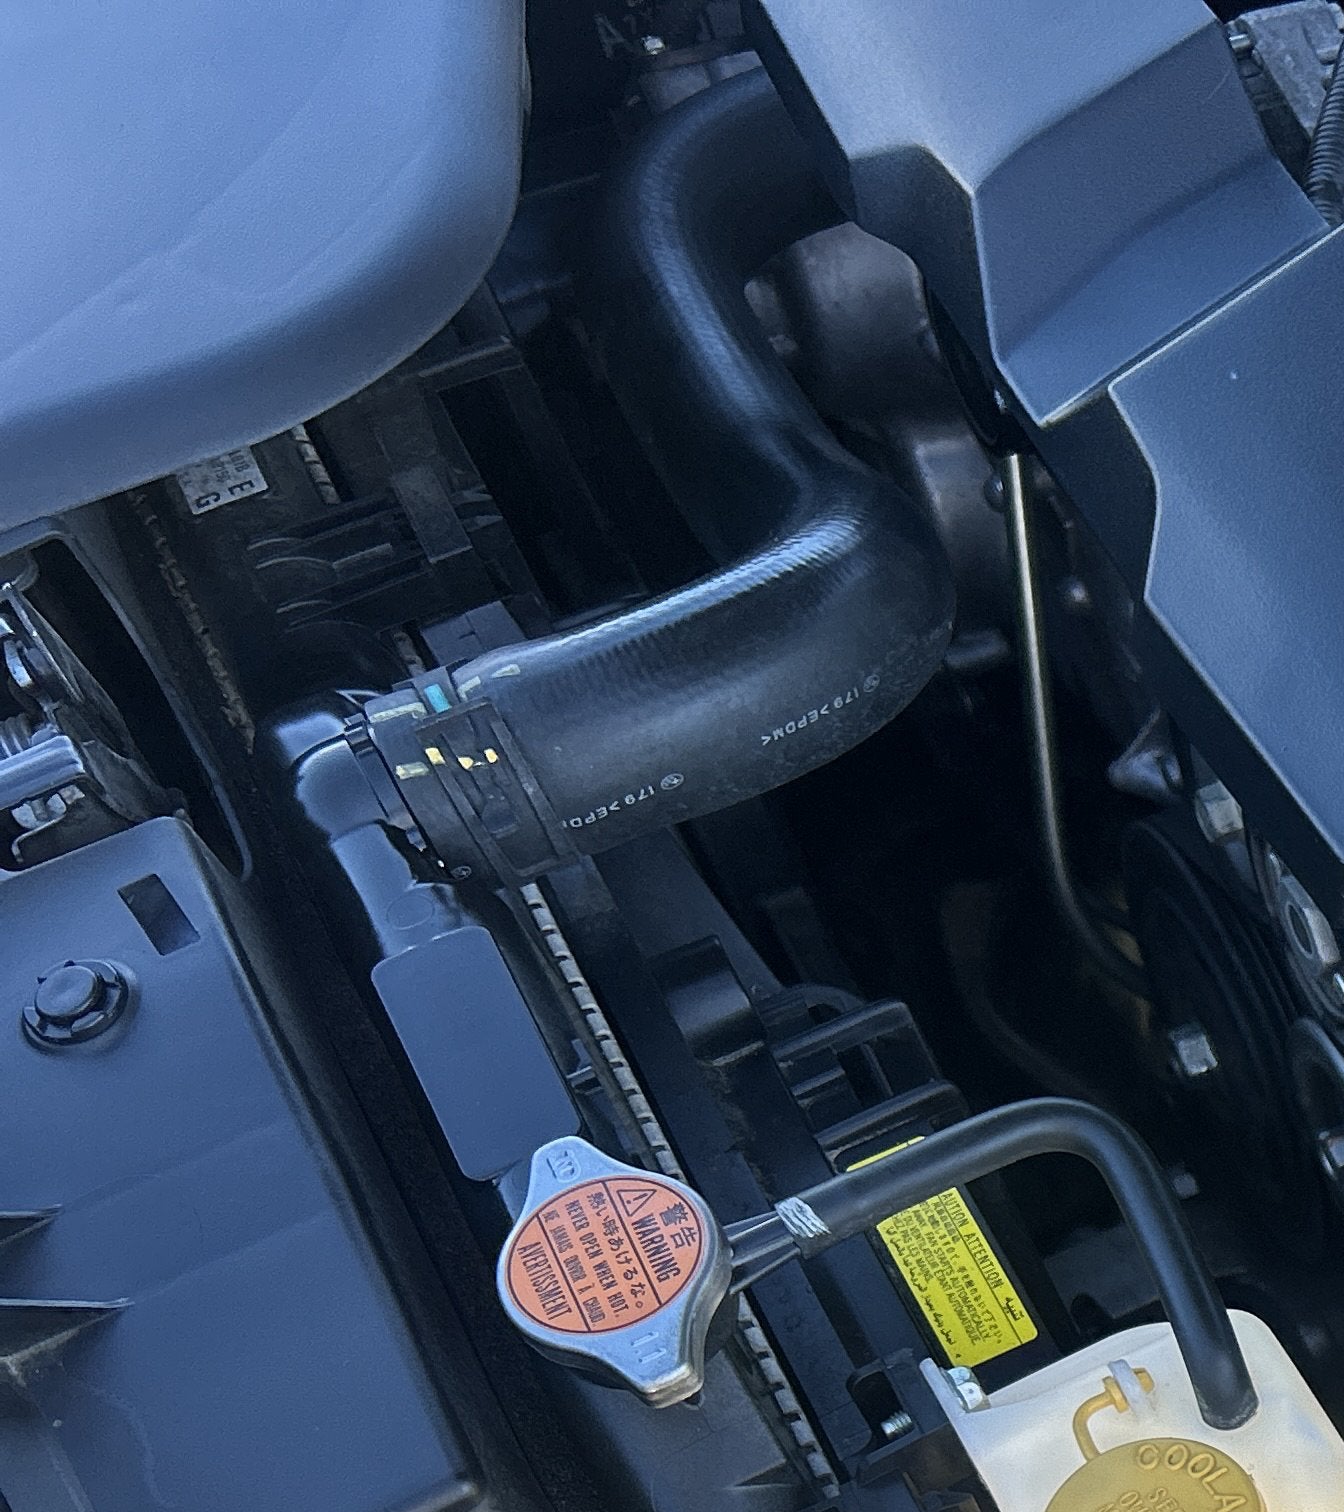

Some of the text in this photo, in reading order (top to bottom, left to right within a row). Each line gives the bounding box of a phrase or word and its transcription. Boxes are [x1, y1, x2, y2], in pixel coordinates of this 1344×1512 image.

[564, 1199, 590, 1232] NEVER
[578, 1231, 603, 1260] OPEN
[592, 1259, 617, 1291] WHEN
[630, 1212, 681, 1284] WARNING
[658, 1200, 699, 1252] 警告
[940, 1190, 969, 1228] AUTION
[963, 1229, 1004, 1289] ATTENTION
[516, 1239, 571, 1322] AVERTISSMENT
